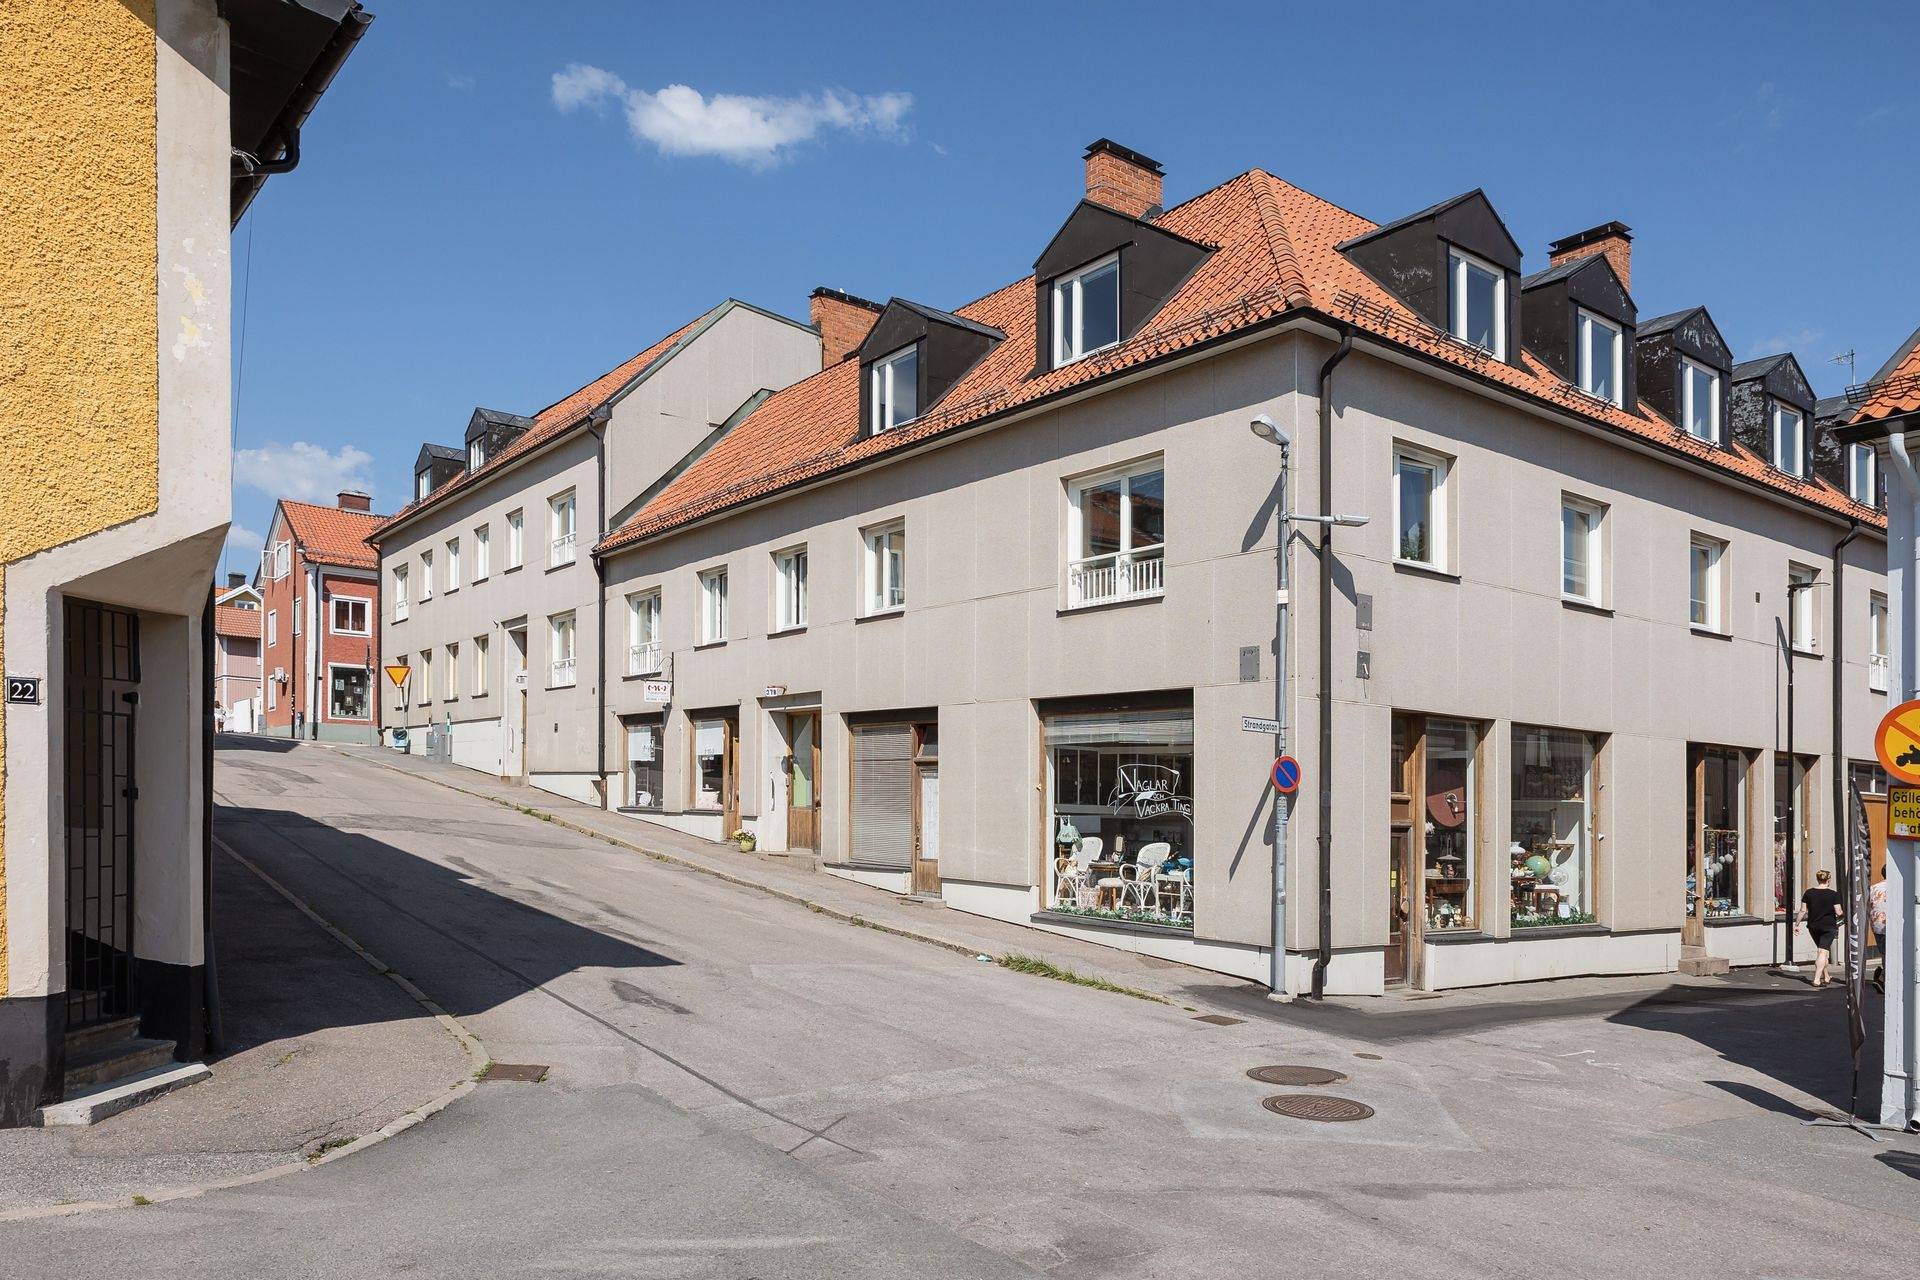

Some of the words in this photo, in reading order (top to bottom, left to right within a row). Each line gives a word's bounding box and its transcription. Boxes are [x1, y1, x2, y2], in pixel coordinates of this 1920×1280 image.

[11, 682, 35, 699] 22
[1244, 719, 1278, 732] Strandgatan
[1120, 768, 1168, 793] NAGLAR
[1135, 800, 1170, 818] VACKRA
